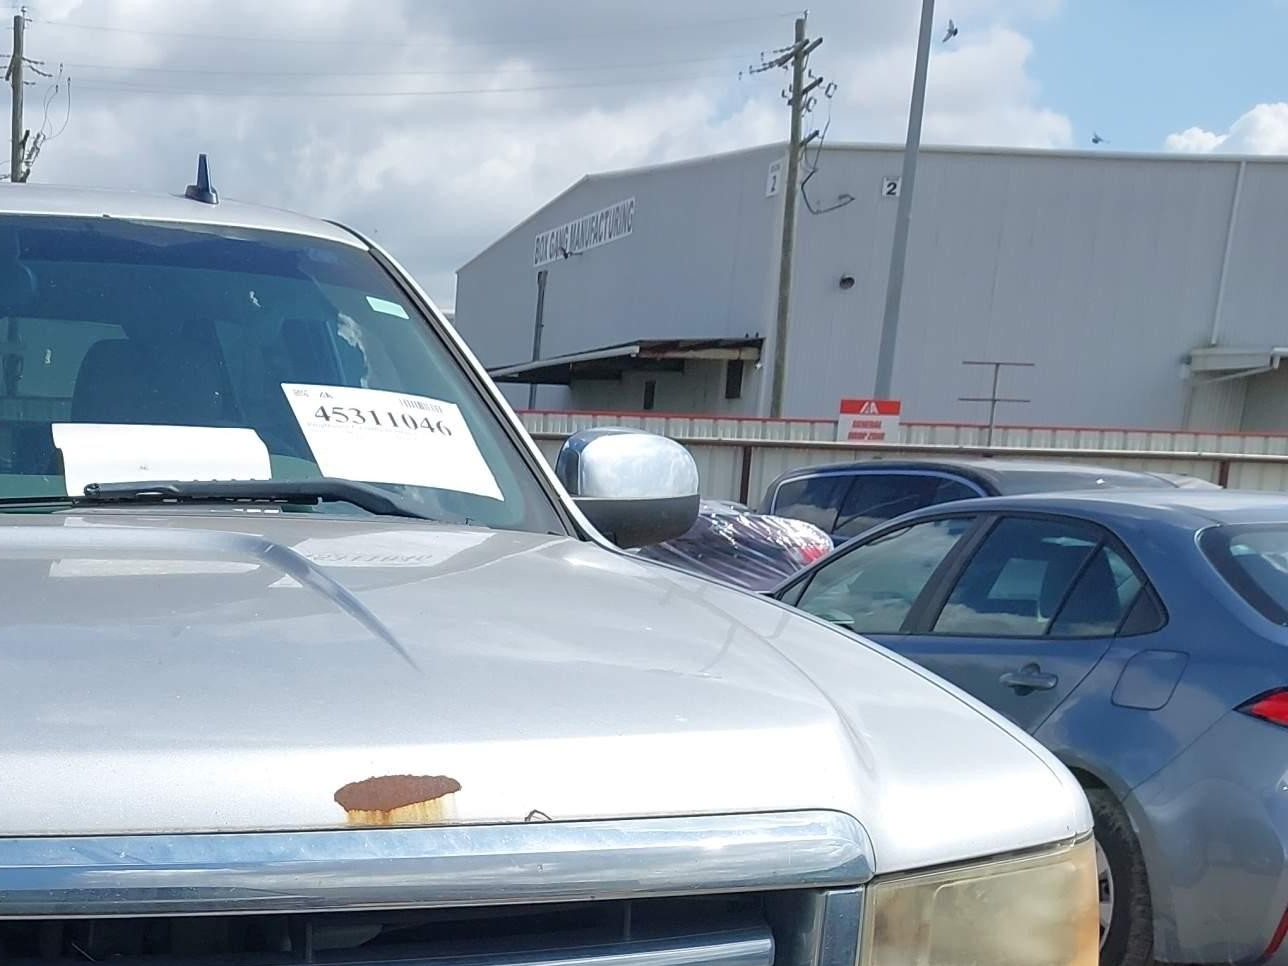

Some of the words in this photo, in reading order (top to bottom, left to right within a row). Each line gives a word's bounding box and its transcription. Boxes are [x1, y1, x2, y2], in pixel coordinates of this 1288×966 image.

[886, 182, 898, 196] 2
[570, 200, 633, 251] MANUFACTURING
[314, 405, 452, 436] 45311046
